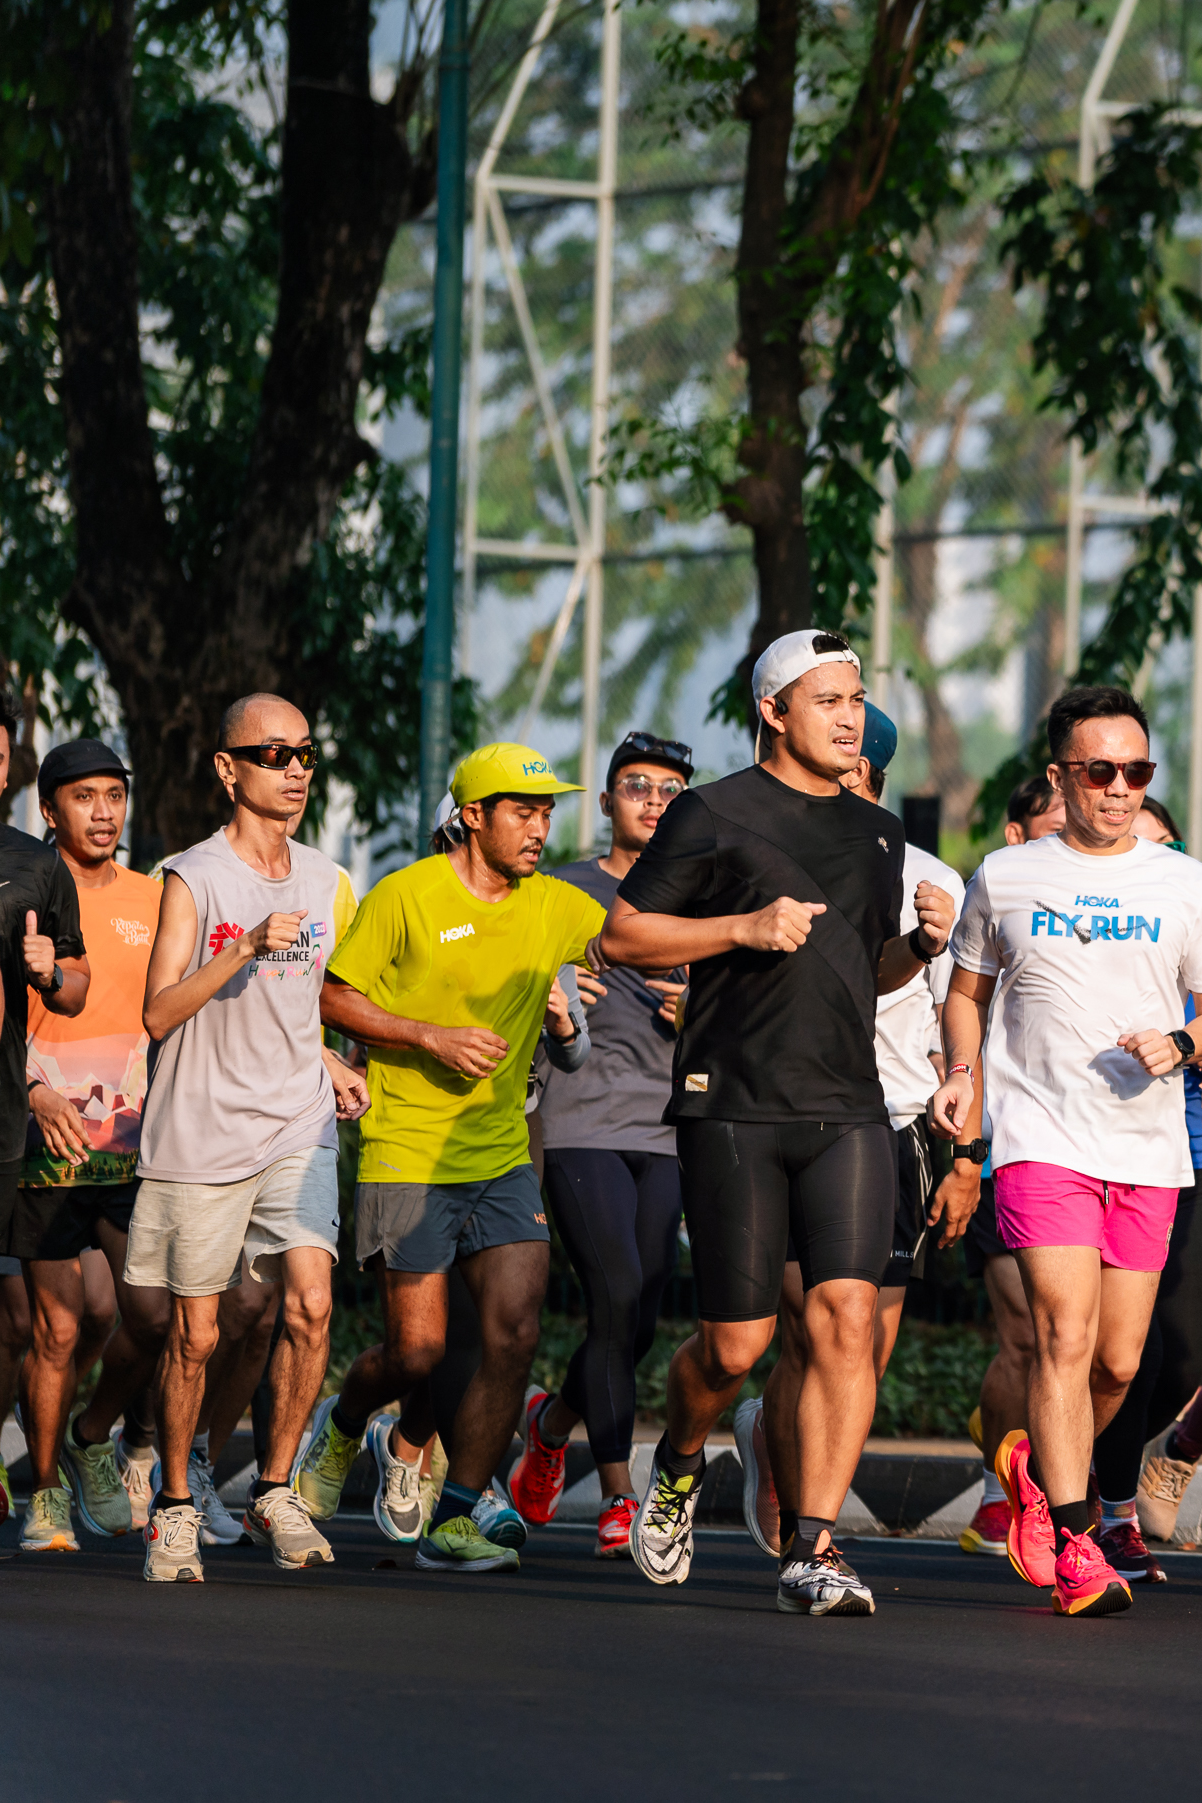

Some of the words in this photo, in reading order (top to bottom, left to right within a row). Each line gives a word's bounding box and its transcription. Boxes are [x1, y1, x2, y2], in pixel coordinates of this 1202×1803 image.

[1074, 895, 1120, 908] HOKA
[440, 922, 476, 944] HOKA
[1031, 911, 1083, 938] FLY
[1090, 915, 1161, 943] RUN
[248, 964, 286, 981] Happy
[533, 1212, 548, 1225] HO
